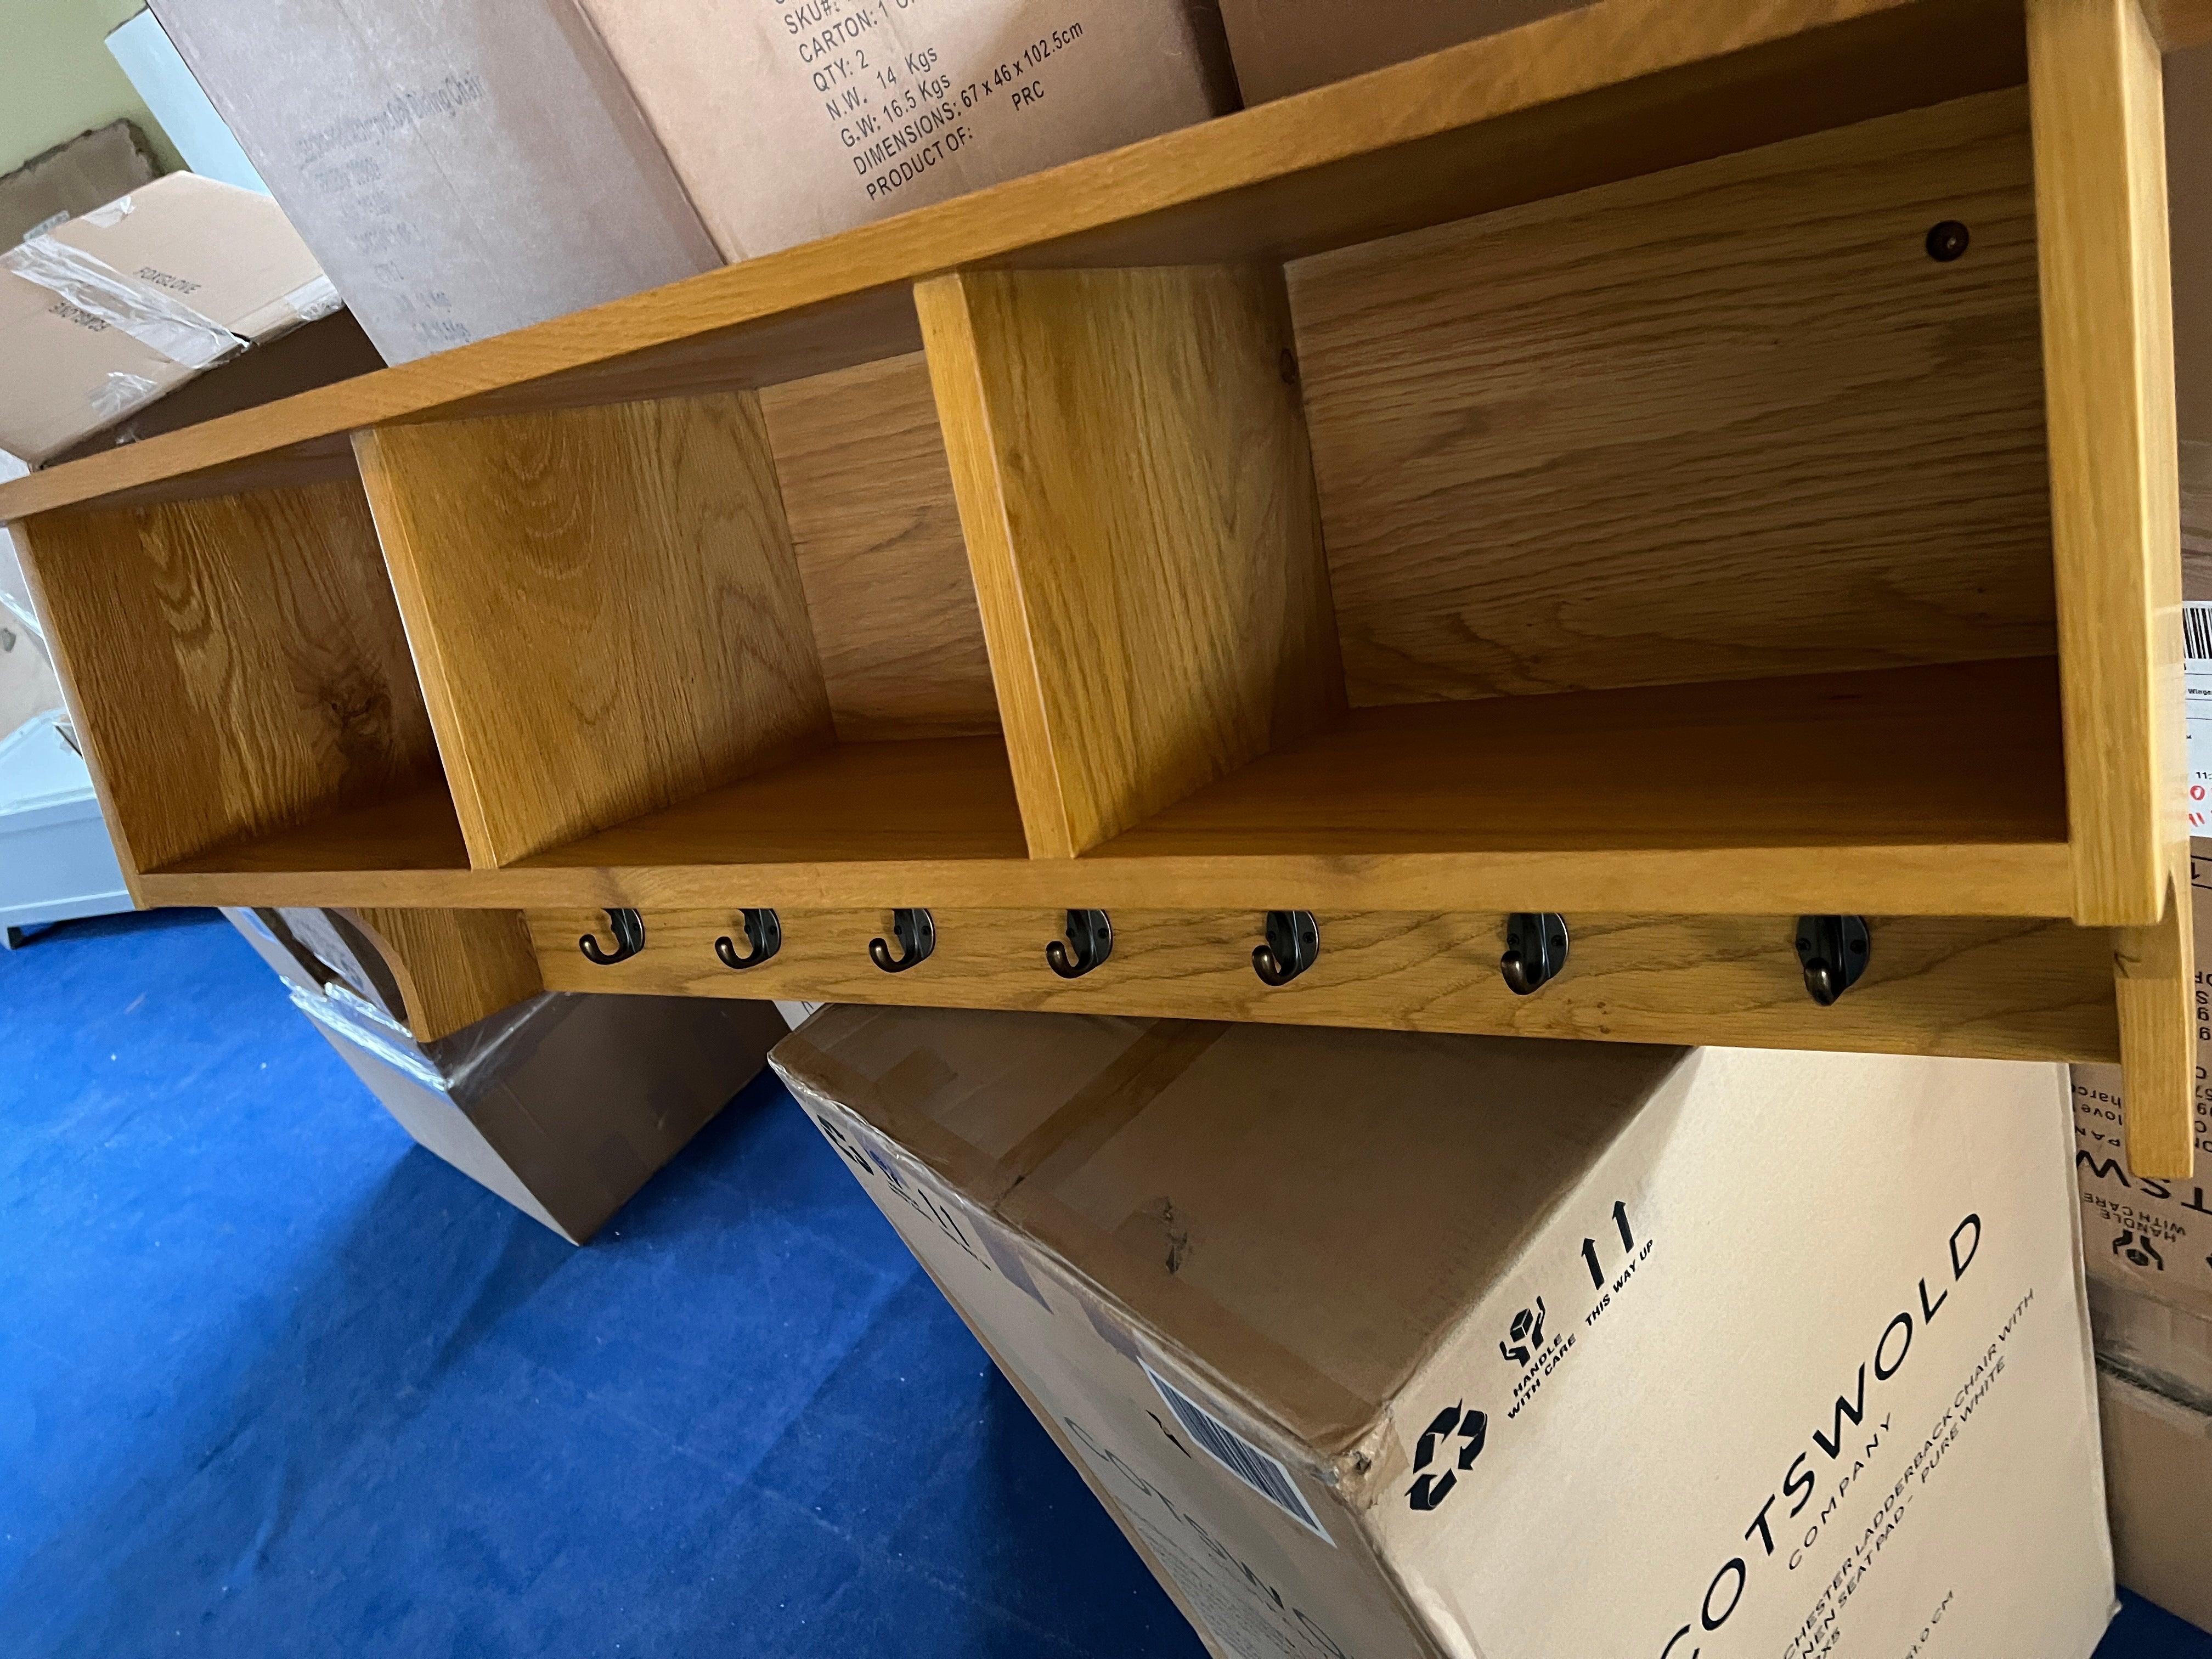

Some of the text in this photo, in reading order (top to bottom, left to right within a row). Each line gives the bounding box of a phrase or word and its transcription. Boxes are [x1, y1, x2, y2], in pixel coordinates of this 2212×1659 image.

[799, 2, 888, 63] CARTON: 1
[877, 66, 897, 89] 14
[905, 47, 938, 75] Kgs
[813, 49, 868, 92] QTY: 2
[853, 22, 1083, 175] DIMENSIONS: 67 x 46 x 102.5cm
[841, 75, 950, 147] G.W: 16.5 Kgs
[866, 80, 1044, 201] PRODUCT OF: PRC
[2083, 1193, 2186, 1235] WITH CARE
[2100, 1208, 2176, 1243] HANDLE
[1585, 1239, 1653, 1326] THIS WAY UP
[1507, 1333, 1576, 1419] WITH CARE
[1513, 1333, 1562, 1397] HANDLE
[1855, 1407, 1953, 1556] LADDERBACK
[1954, 1344, 1996, 1408] CHAIR
[1998, 1288, 2034, 1341] WITH
[1788, 1412, 1891, 1570] COMPANY
[1838, 1549, 1873, 1609] SEAT
[1921, 1422, 1959, 1483] PURE
[1960, 1355, 2005, 1421] WHITE
[1931, 1590, 1954, 1624] CM
